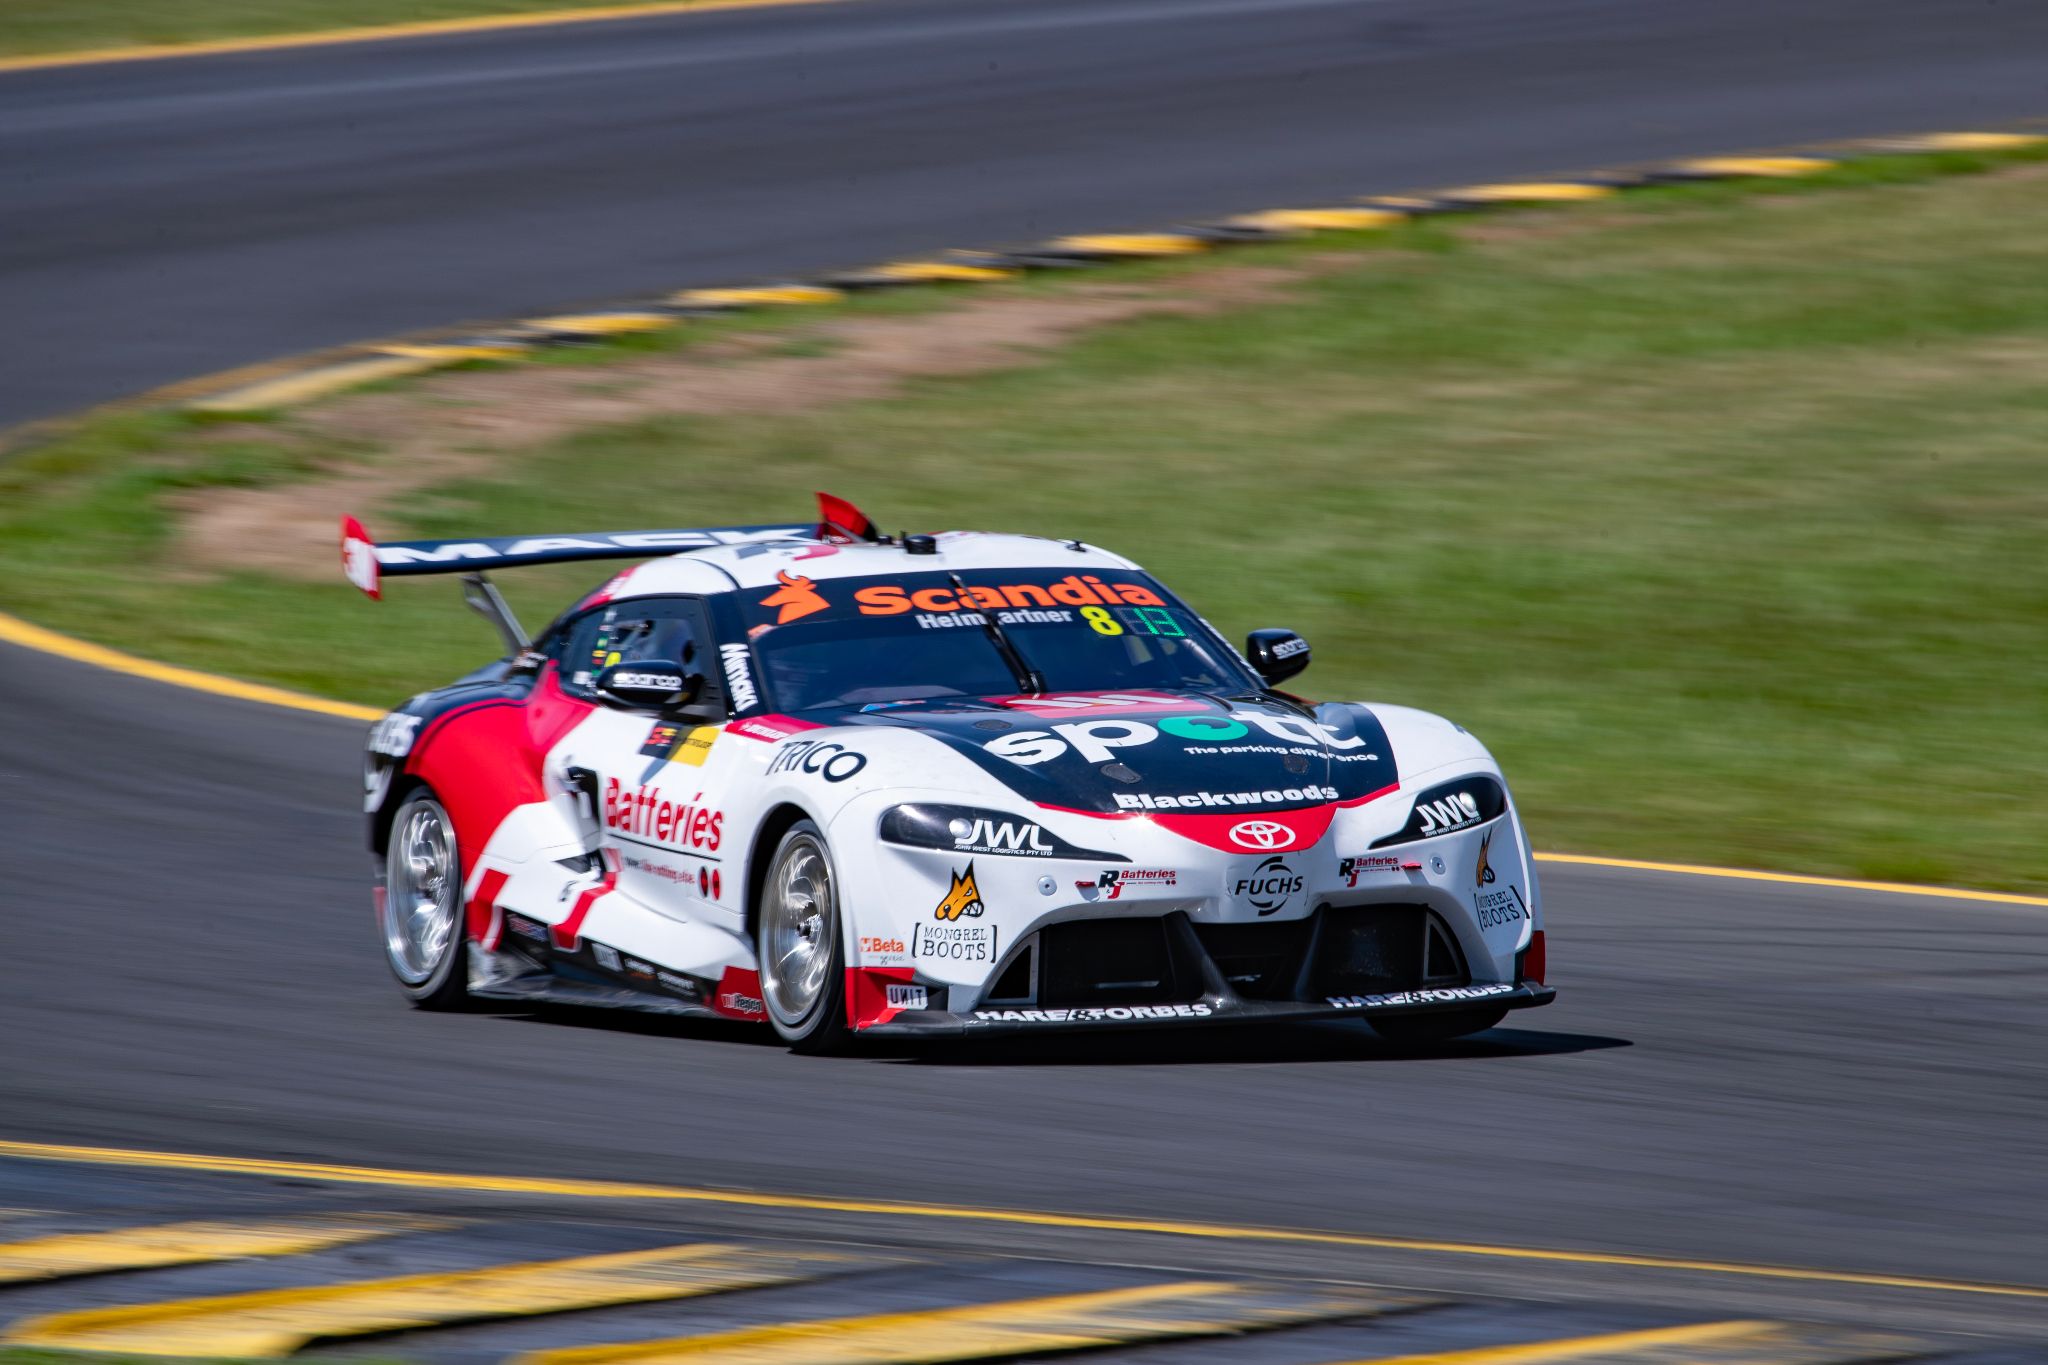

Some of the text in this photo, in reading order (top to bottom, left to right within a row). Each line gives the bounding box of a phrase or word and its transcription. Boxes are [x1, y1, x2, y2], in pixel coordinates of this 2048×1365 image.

[372, 528, 819, 564] MACK
[854, 576, 1167, 615] Scandia
[915, 609, 1074, 629] Heimartner
[1080, 606, 1123, 636] 8
[613, 673, 682, 691] sparco
[765, 740, 868, 783] TRICO
[1184, 744, 1379, 762] The parking difference
[1112, 785, 1339, 810] Blackwoods
[606, 777, 723, 851] Batteries
[1416, 794, 1479, 832] JWL
[955, 819, 1053, 851] JWL
[1356, 856, 1399, 867] Batteries
[1121, 869, 1176, 879] Batteries
[1235, 876, 1304, 895] FUCHS
[1481, 903, 1520, 928] BOOTS
[923, 926, 987, 941] MONGREL
[872, 937, 905, 953] Beta
[922, 940, 986, 960] BOOTS
